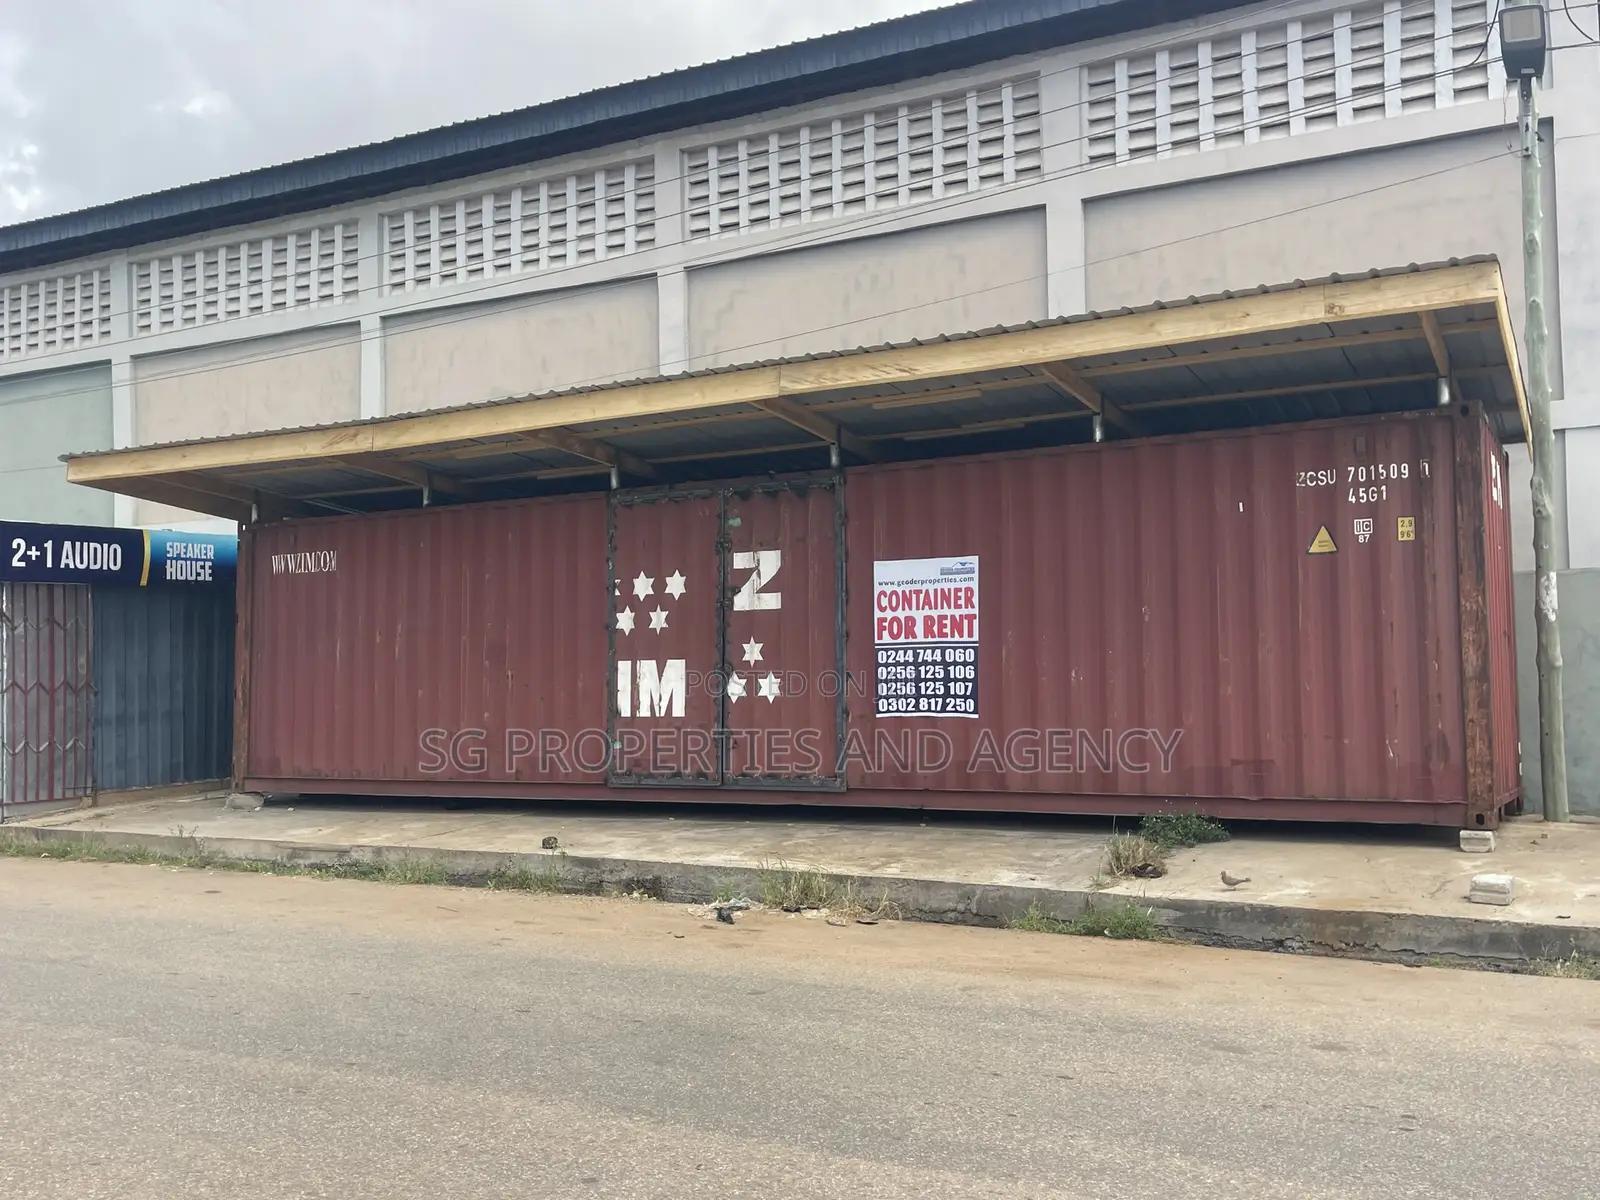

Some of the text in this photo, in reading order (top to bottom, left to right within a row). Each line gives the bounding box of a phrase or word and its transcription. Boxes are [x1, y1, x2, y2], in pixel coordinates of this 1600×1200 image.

[1347, 463, 1409, 482] 701509
[1348, 485, 1387, 503] 45G1
[1358, 535, 1370, 543] 87
[11, 538, 122, 571] 2+1 AUDIO
[166, 541, 214, 560] SPEAKER
[165, 560, 213, 581] HOUSE
[733, 549, 782, 611] Z
[876, 587, 975, 613] CONTAINER
[876, 613, 977, 640] FOR RENT
[878, 648, 975, 663] 0244 744 060
[878, 665, 975, 679] 0256 125 106
[617, 659, 686, 717] IM
[878, 681, 973, 695] 0256 125 107
[878, 697, 975, 712] 0302 817 250
